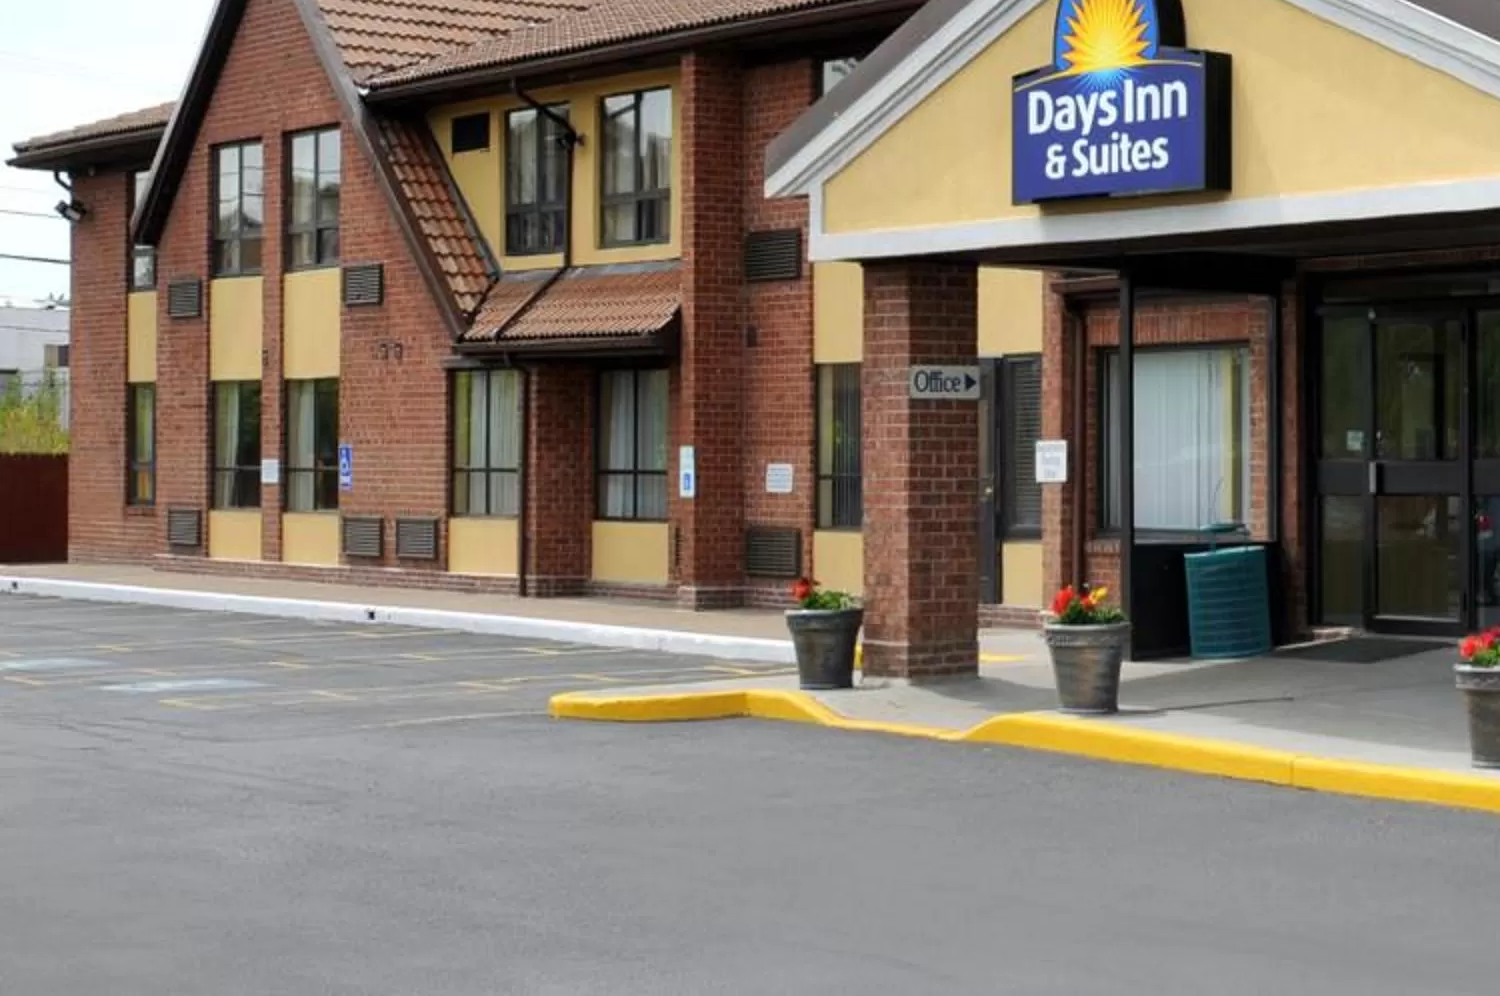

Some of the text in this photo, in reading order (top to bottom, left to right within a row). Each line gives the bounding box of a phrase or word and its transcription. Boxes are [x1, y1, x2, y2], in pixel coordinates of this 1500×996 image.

[1028, 78, 1188, 136] Days Inn
[1045, 131, 1169, 179] & Suites
[914, 369, 961, 393] Office
